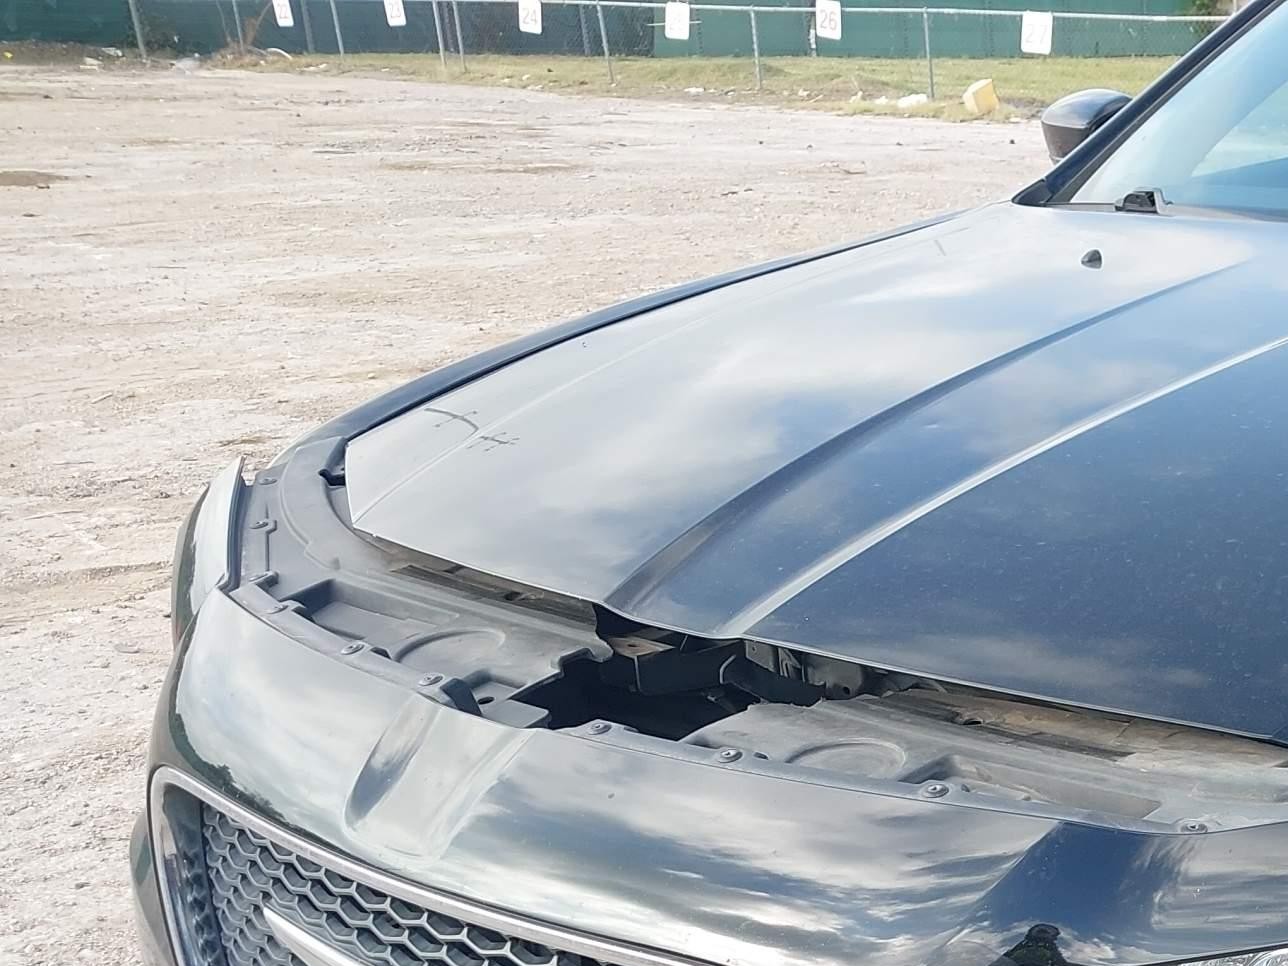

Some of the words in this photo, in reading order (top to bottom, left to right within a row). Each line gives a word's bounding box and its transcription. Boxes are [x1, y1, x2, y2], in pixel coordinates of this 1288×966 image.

[522, 7, 538, 25] 24
[819, 9, 837, 31] 26
[1025, 23, 1049, 45] 27
